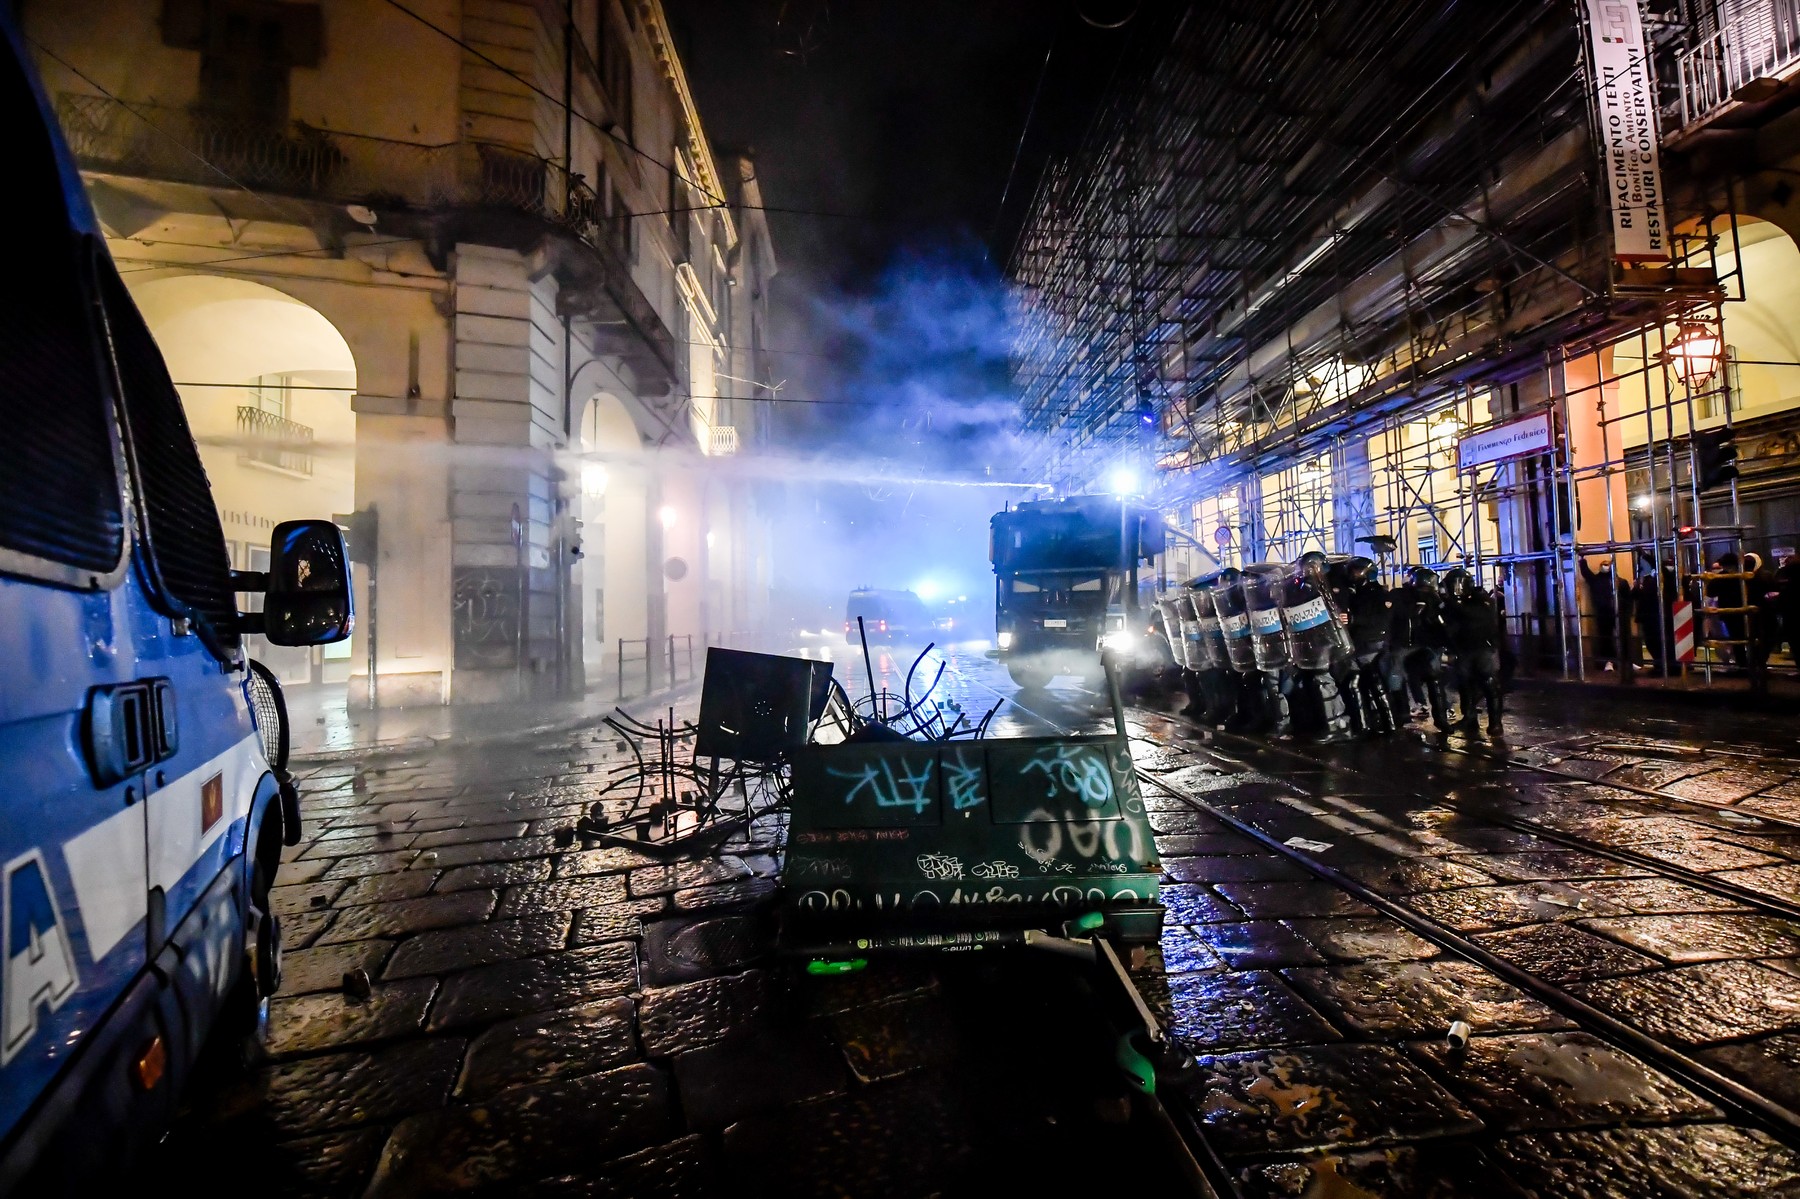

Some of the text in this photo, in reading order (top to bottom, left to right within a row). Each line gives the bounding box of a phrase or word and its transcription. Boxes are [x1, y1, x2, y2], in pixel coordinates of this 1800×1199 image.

[1603, 66, 1632, 229] RIFACIMENTO TETTI
[1627, 48, 1661, 250] RESTAURI CONSERVATIVI
[1289, 607, 1322, 626] POLIZIA
